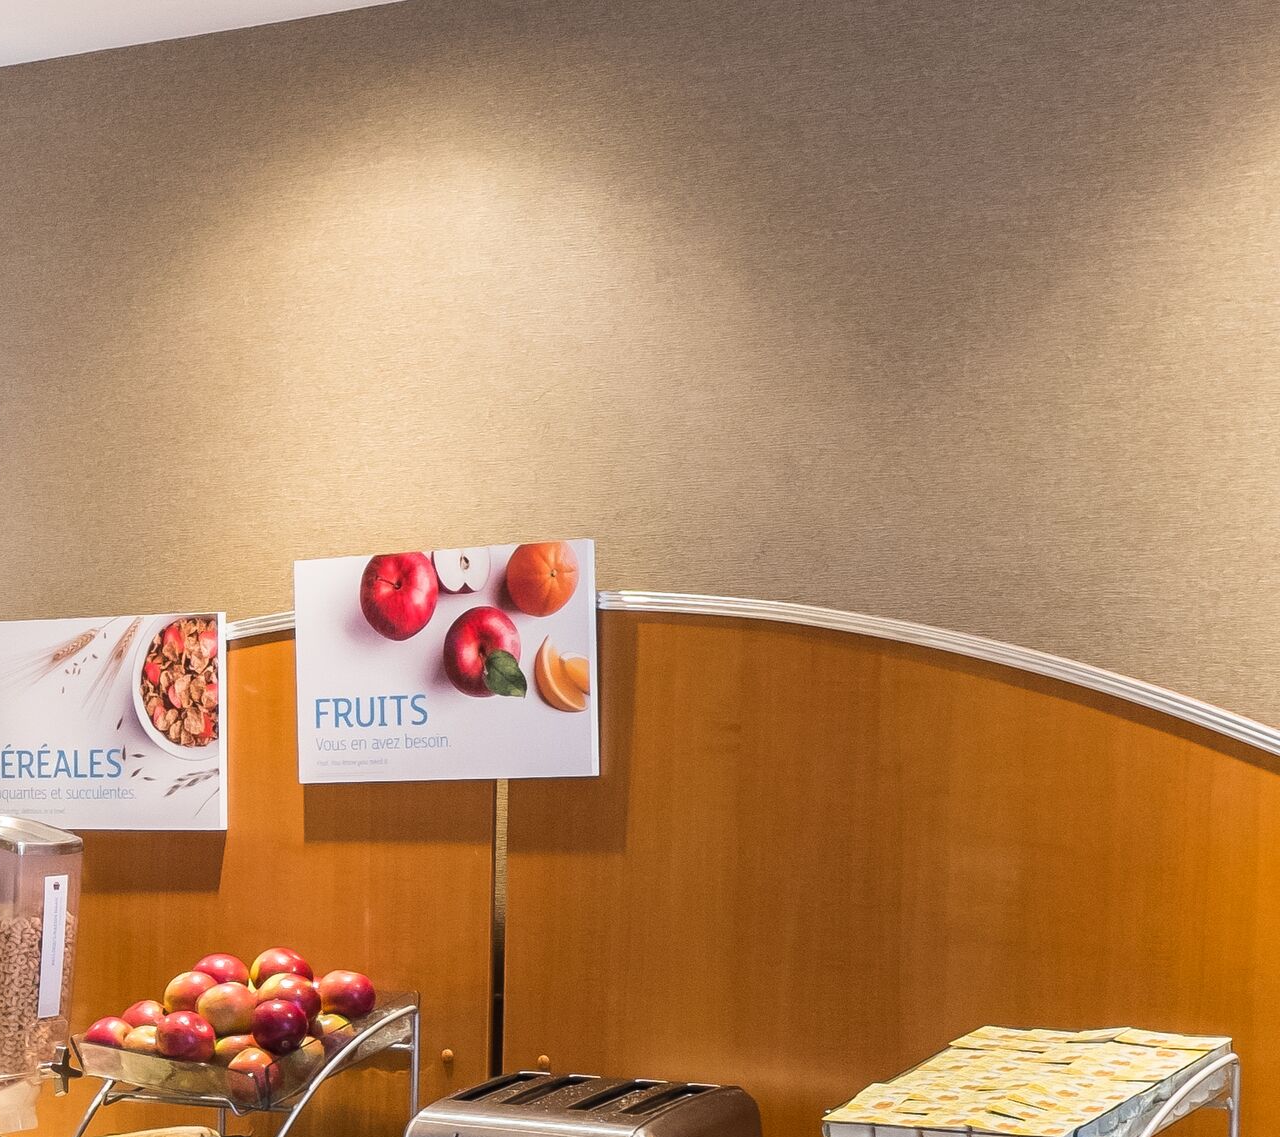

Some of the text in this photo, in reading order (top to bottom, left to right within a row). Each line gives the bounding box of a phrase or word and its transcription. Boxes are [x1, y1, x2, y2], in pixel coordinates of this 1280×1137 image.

[314, 694, 429, 729] FRUITS
[315, 734, 453, 752] Vous en avez besoin.
[50, 787, 64, 800] et
[66, 785, 138, 800] succulentes.
